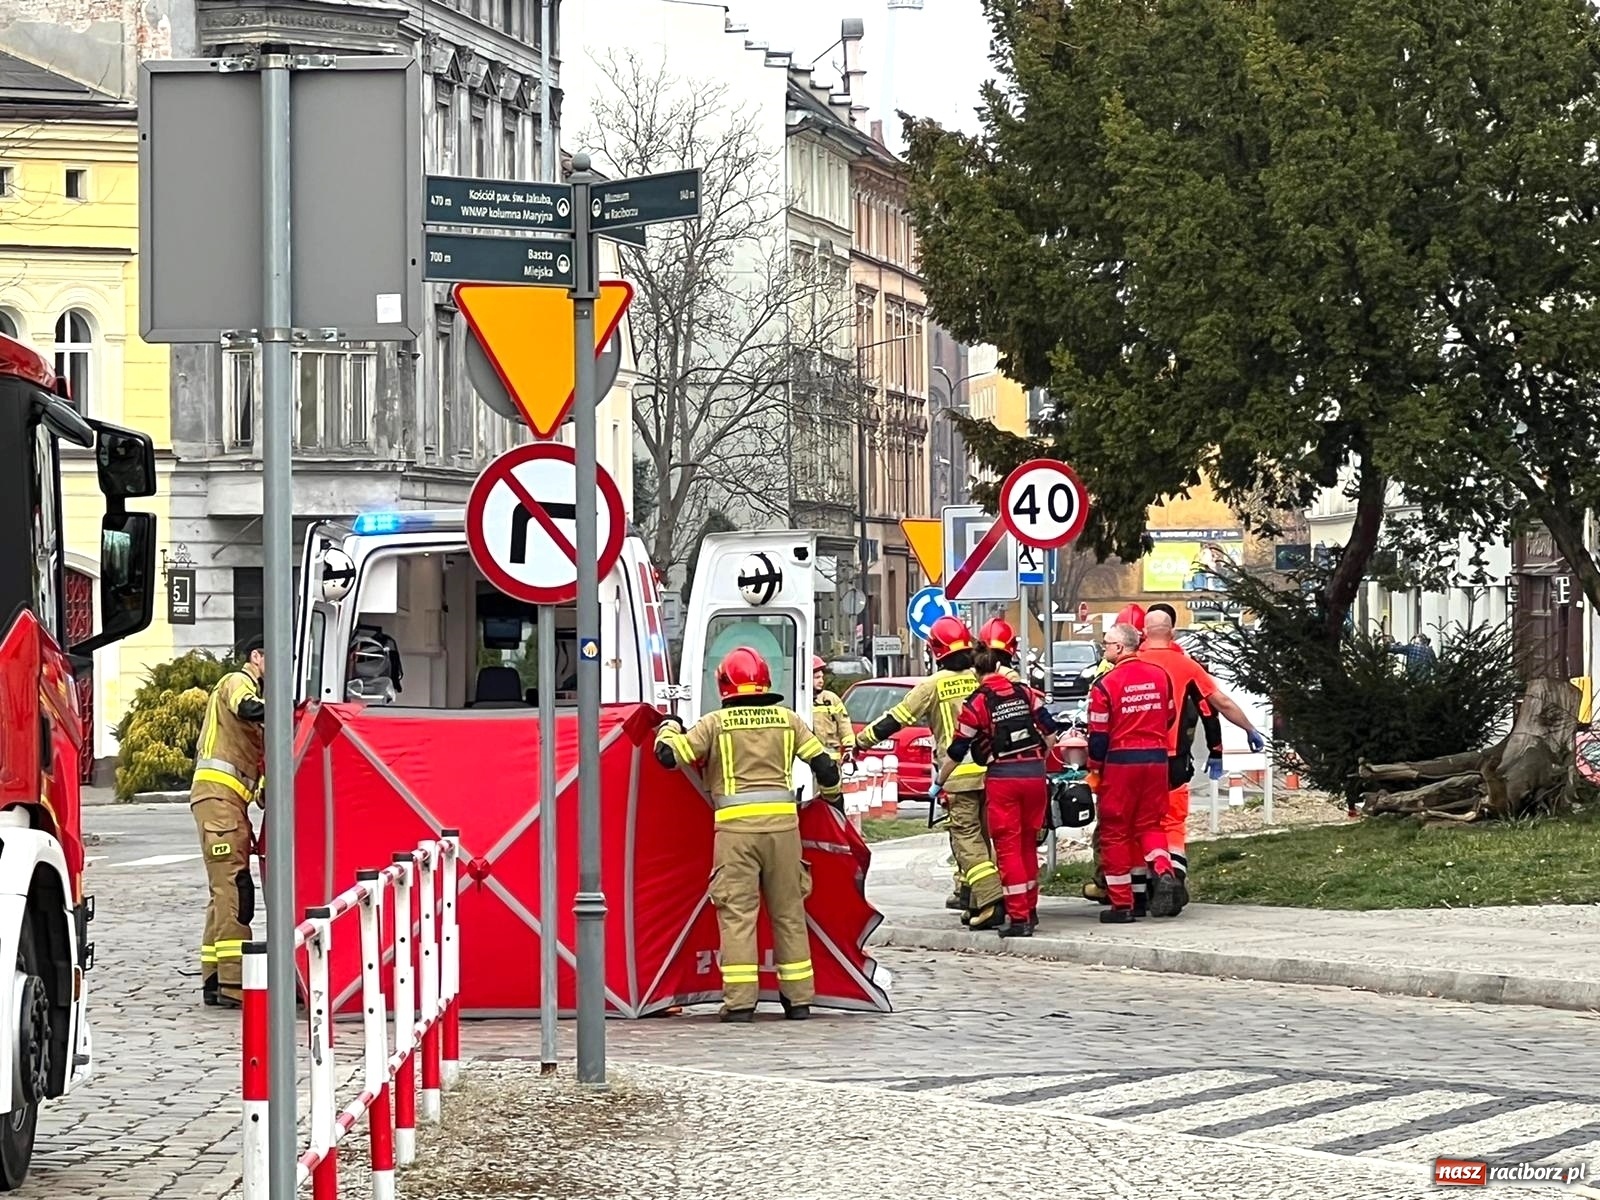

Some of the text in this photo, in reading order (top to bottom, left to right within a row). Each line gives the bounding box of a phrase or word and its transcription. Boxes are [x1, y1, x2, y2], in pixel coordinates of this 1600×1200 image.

[430, 195, 443, 206] 470
[469, 189, 495, 200] Kościół
[461, 206, 553, 224] WNMP kolumna Maryjna
[604, 212, 610, 220] w
[430, 251, 451, 263] 700 m
[528, 249, 553, 260] Baszta
[524, 265, 553, 280] Miejska
[1013, 483, 1074, 524] 40
[173, 585, 180, 601] 5
